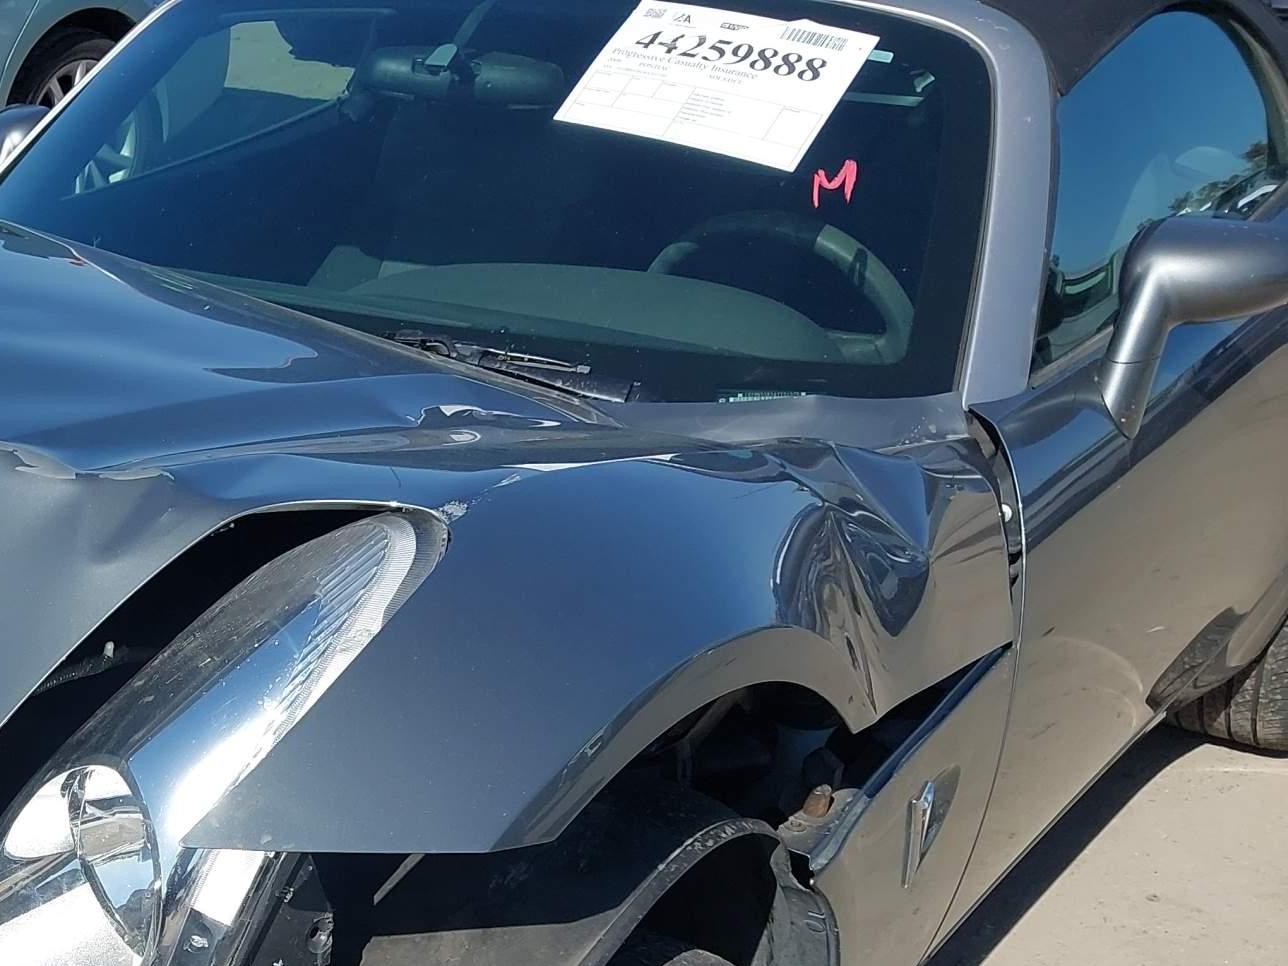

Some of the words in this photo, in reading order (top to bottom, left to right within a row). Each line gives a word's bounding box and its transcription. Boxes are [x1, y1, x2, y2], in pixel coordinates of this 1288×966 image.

[612, 47, 666, 64] Progressive
[667, 55, 707, 72] Casualty
[710, 64, 759, 80] Insurance
[634, 30, 828, 82] 44259888
[812, 158, 858, 209] M
